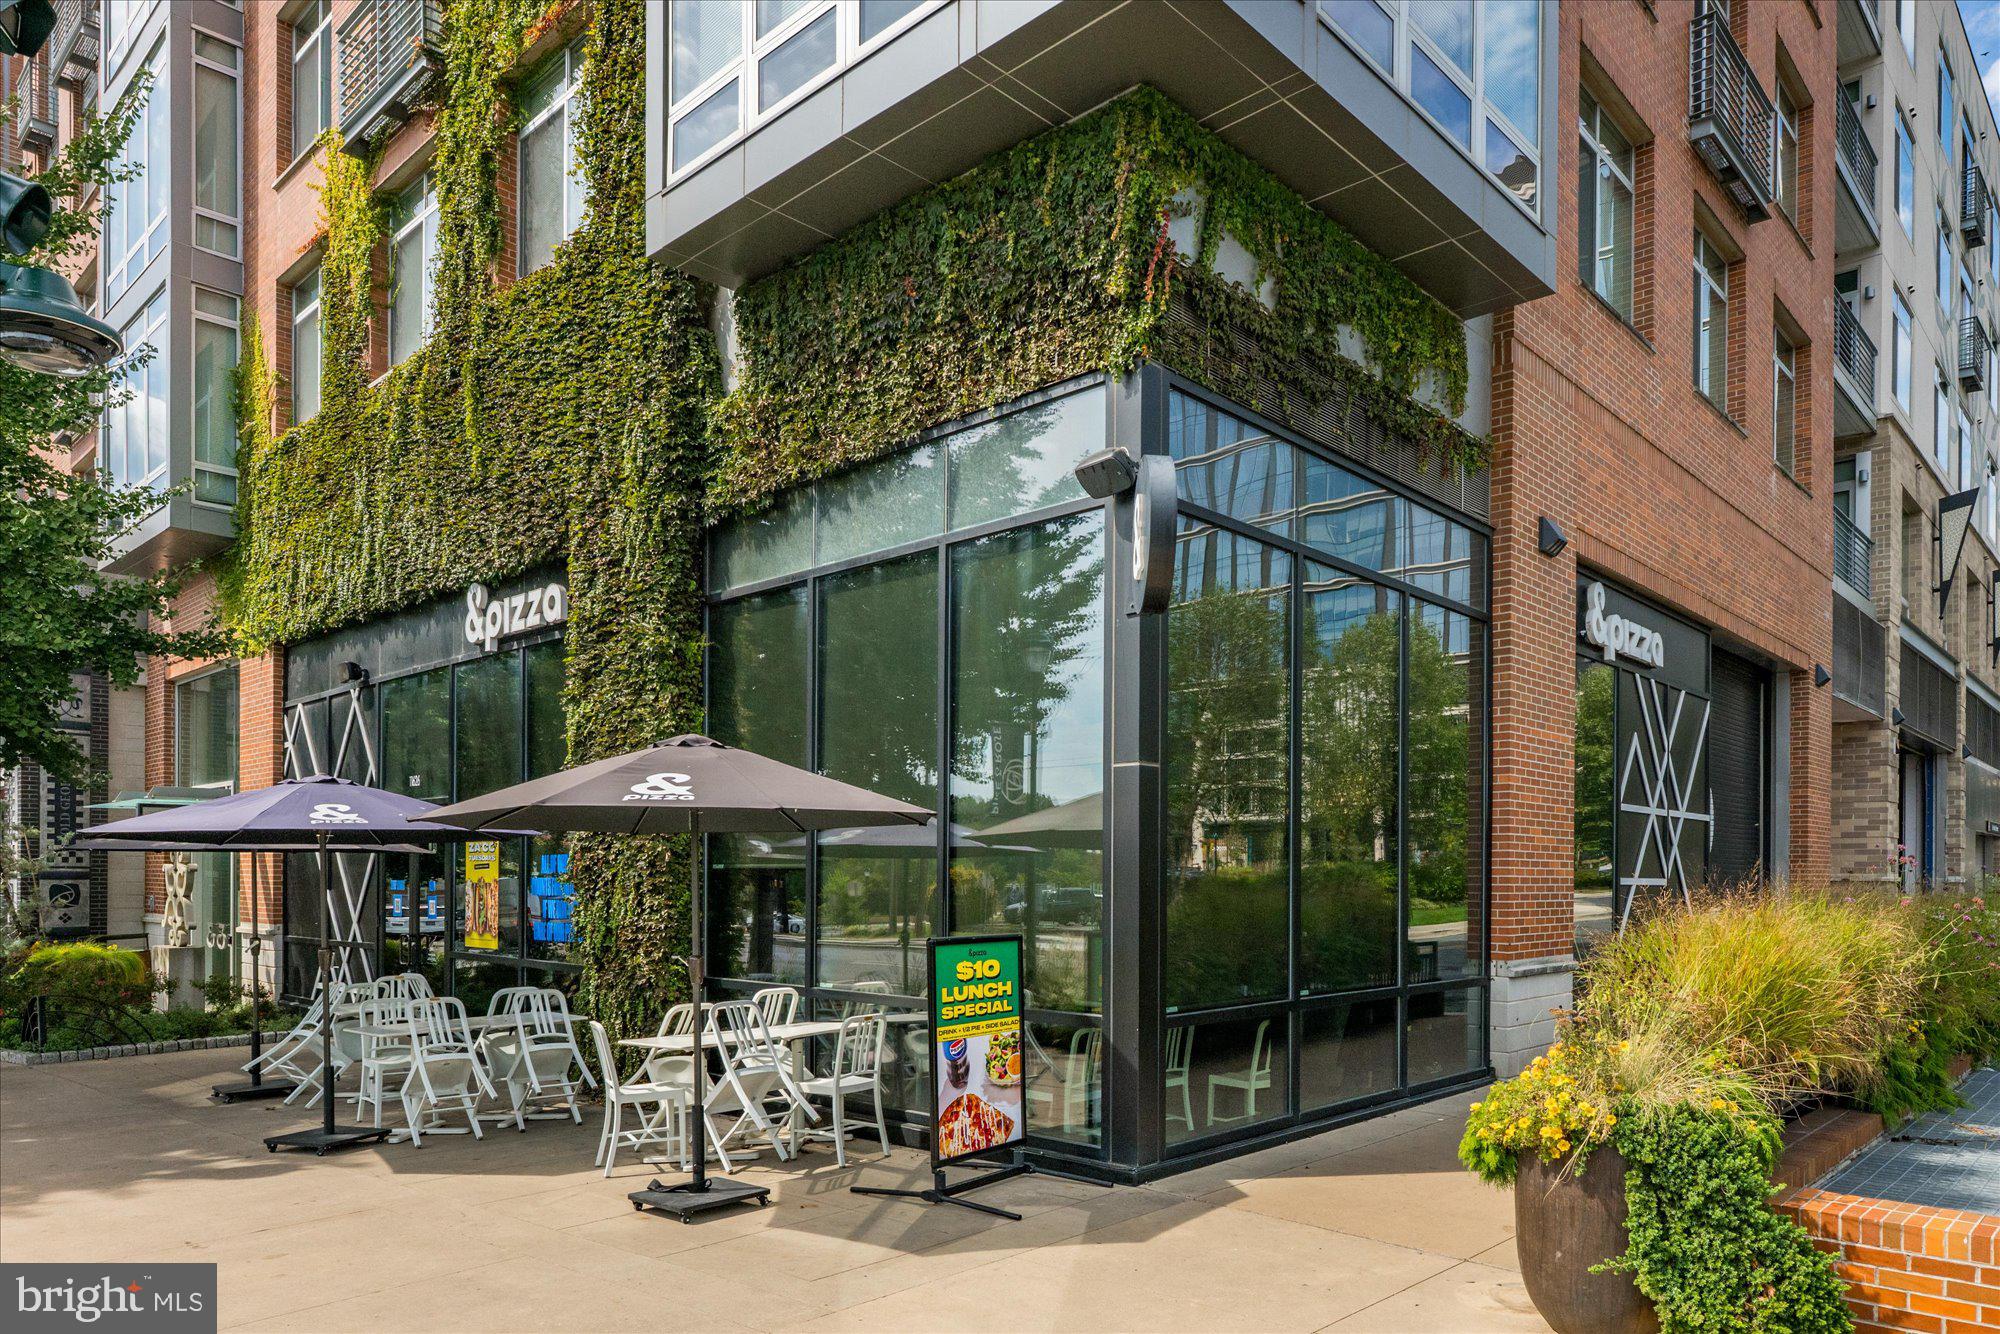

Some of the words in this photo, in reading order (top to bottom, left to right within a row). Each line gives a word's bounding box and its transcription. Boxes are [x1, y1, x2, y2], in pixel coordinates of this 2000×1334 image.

[465, 582, 567, 652] &pizza
[1586, 582, 1664, 667] &pizza
[956, 959, 1001, 981] $10
[941, 981, 1013, 1003] LUNCH
[941, 1000, 1013, 1020] SPECIAL
[938, 1029, 958, 1037] DRINK
[971, 1024, 981, 1032] PIE
[985, 1022, 999, 1030] SIDE
[999, 1020, 1019, 1028] SALAD
